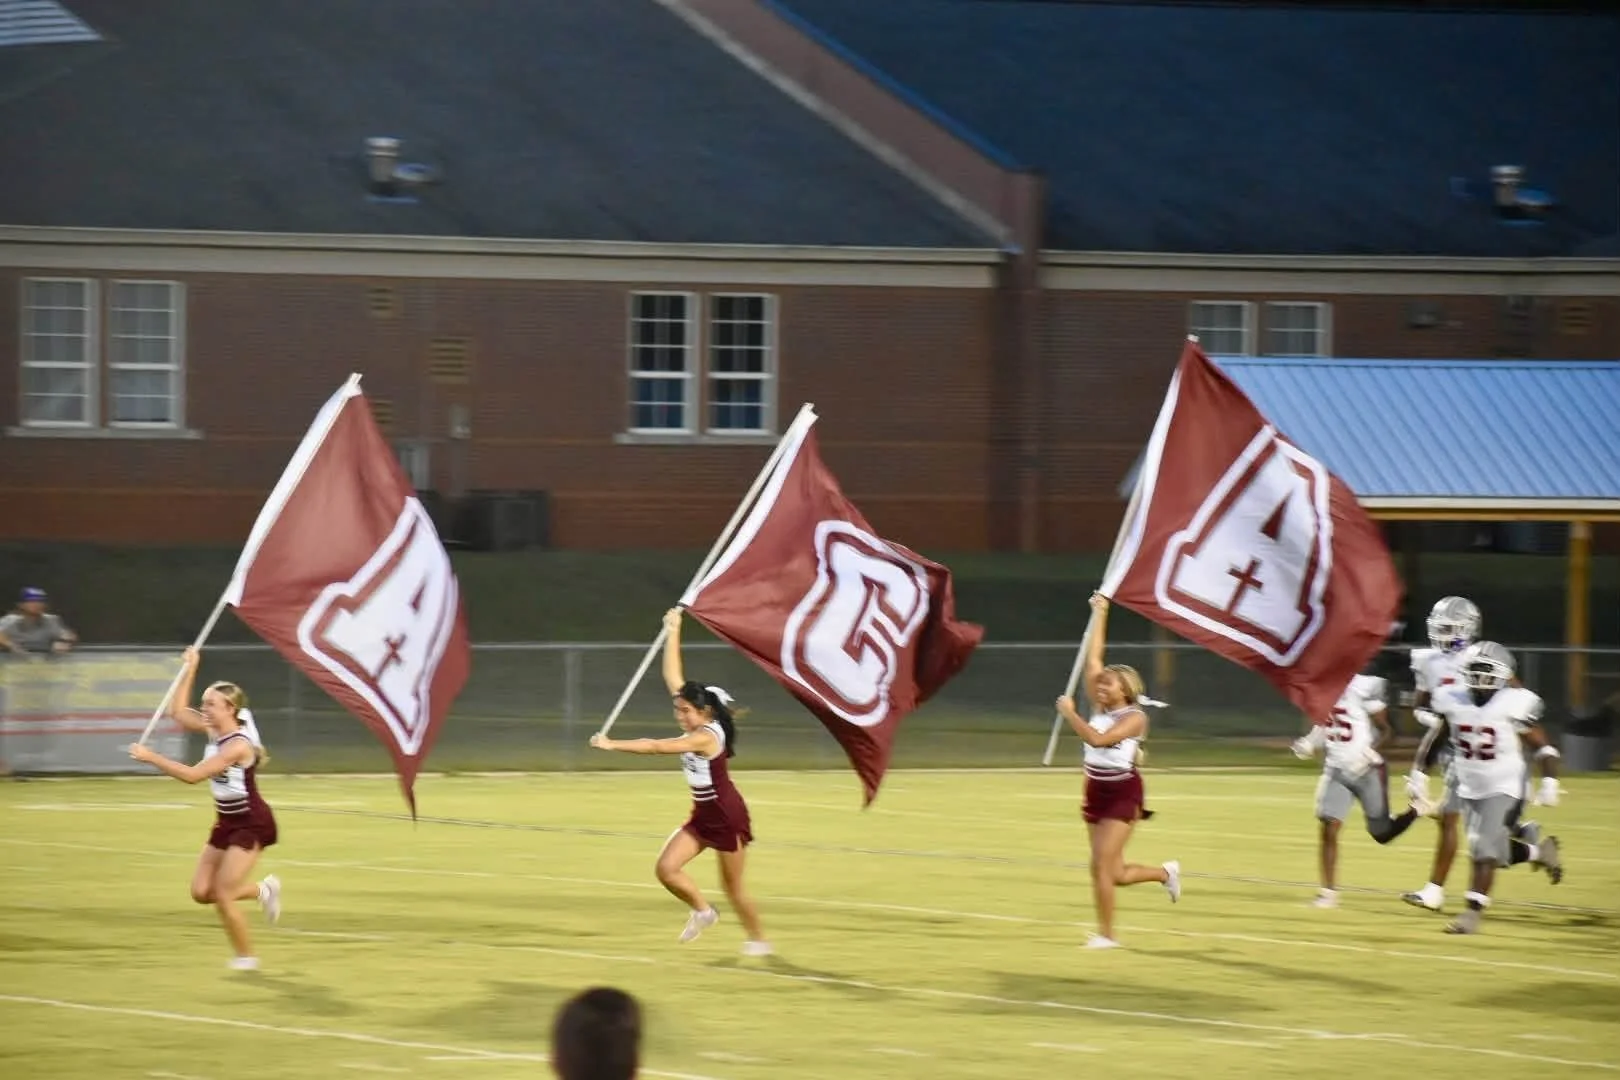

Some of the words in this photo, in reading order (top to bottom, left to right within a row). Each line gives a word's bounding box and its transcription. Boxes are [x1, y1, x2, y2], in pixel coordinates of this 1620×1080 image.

[298, 496, 458, 755] A
[1155, 425, 1333, 666] A
[1456, 724, 1496, 761] 52
